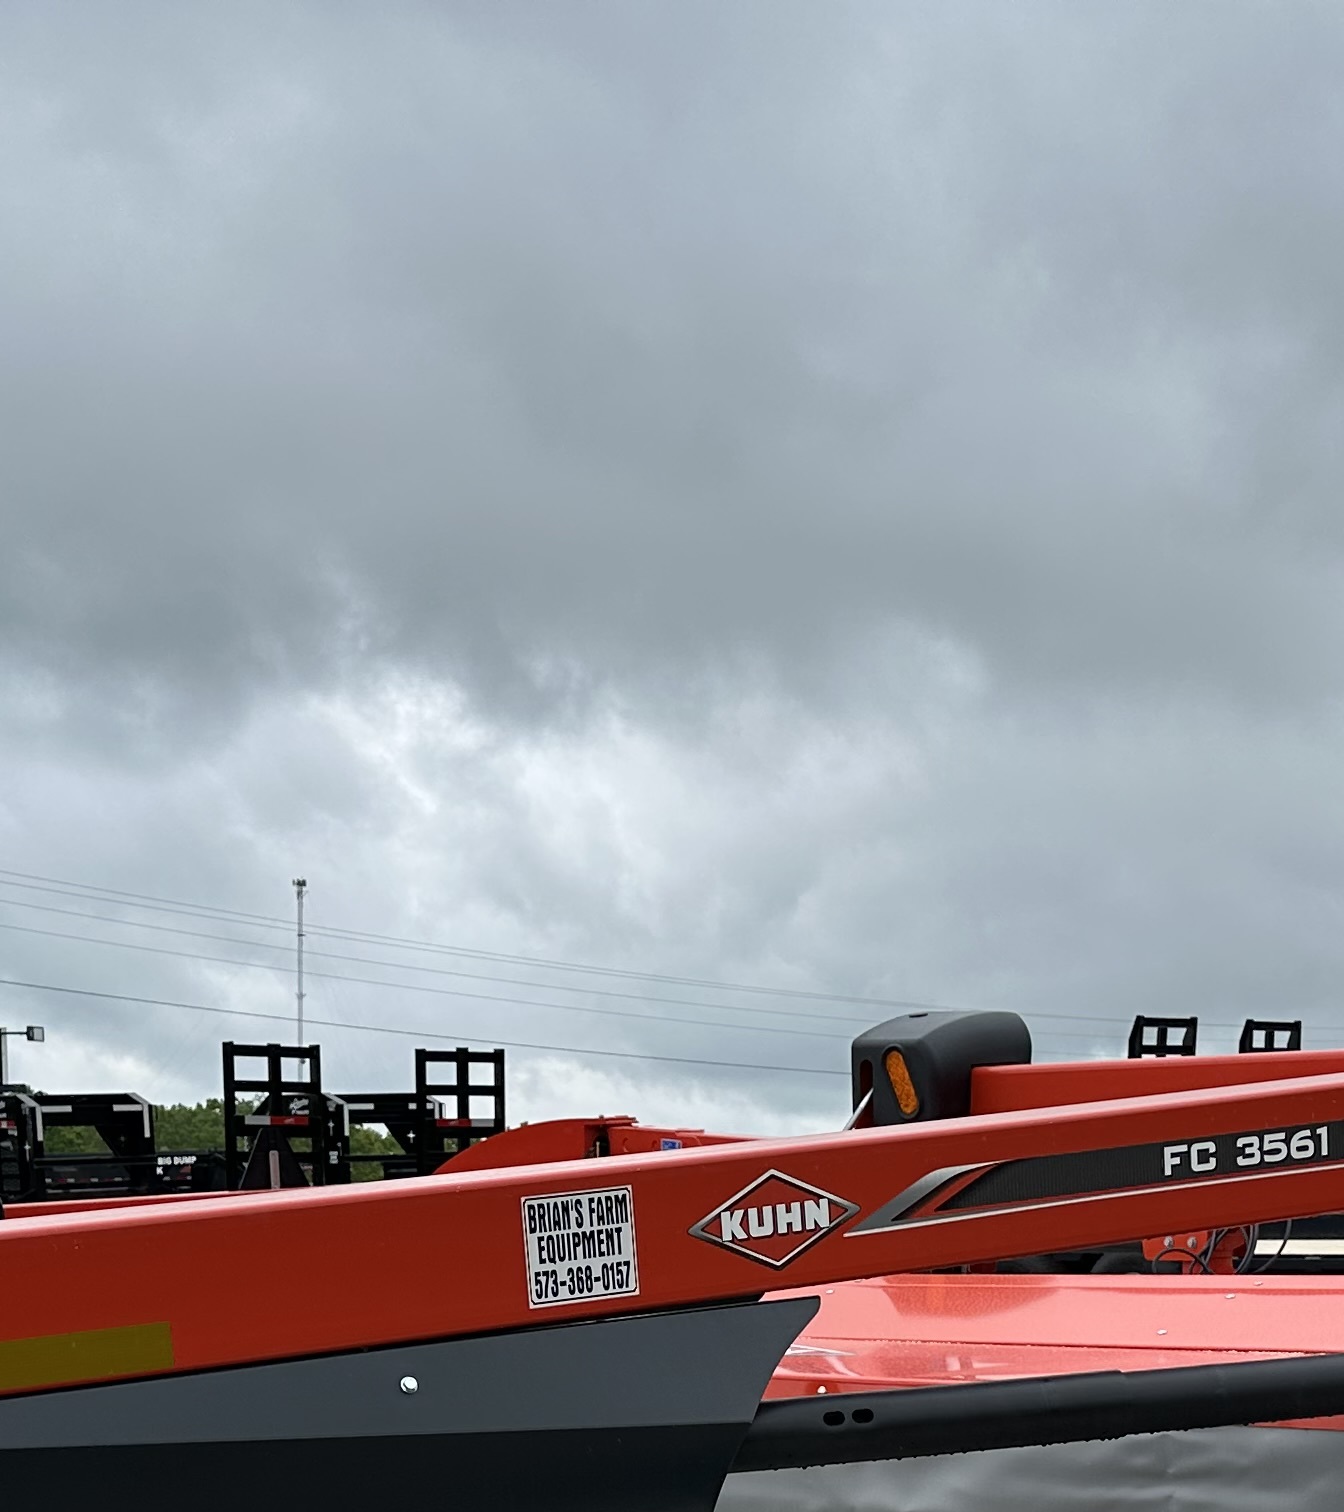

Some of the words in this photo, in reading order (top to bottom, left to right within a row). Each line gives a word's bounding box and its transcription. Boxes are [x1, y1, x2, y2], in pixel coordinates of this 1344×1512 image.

[173, 1155, 197, 1165] DUMP
[1163, 1140, 1216, 1176] FC
[1236, 1126, 1329, 1167] 3561
[527, 1197, 585, 1235] BRIAN'S
[588, 1193, 629, 1228] FARM
[720, 1198, 831, 1243] KUHN
[537, 1227, 623, 1266] EQUIPMENT
[534, 1260, 631, 1300] 573-368-0157
